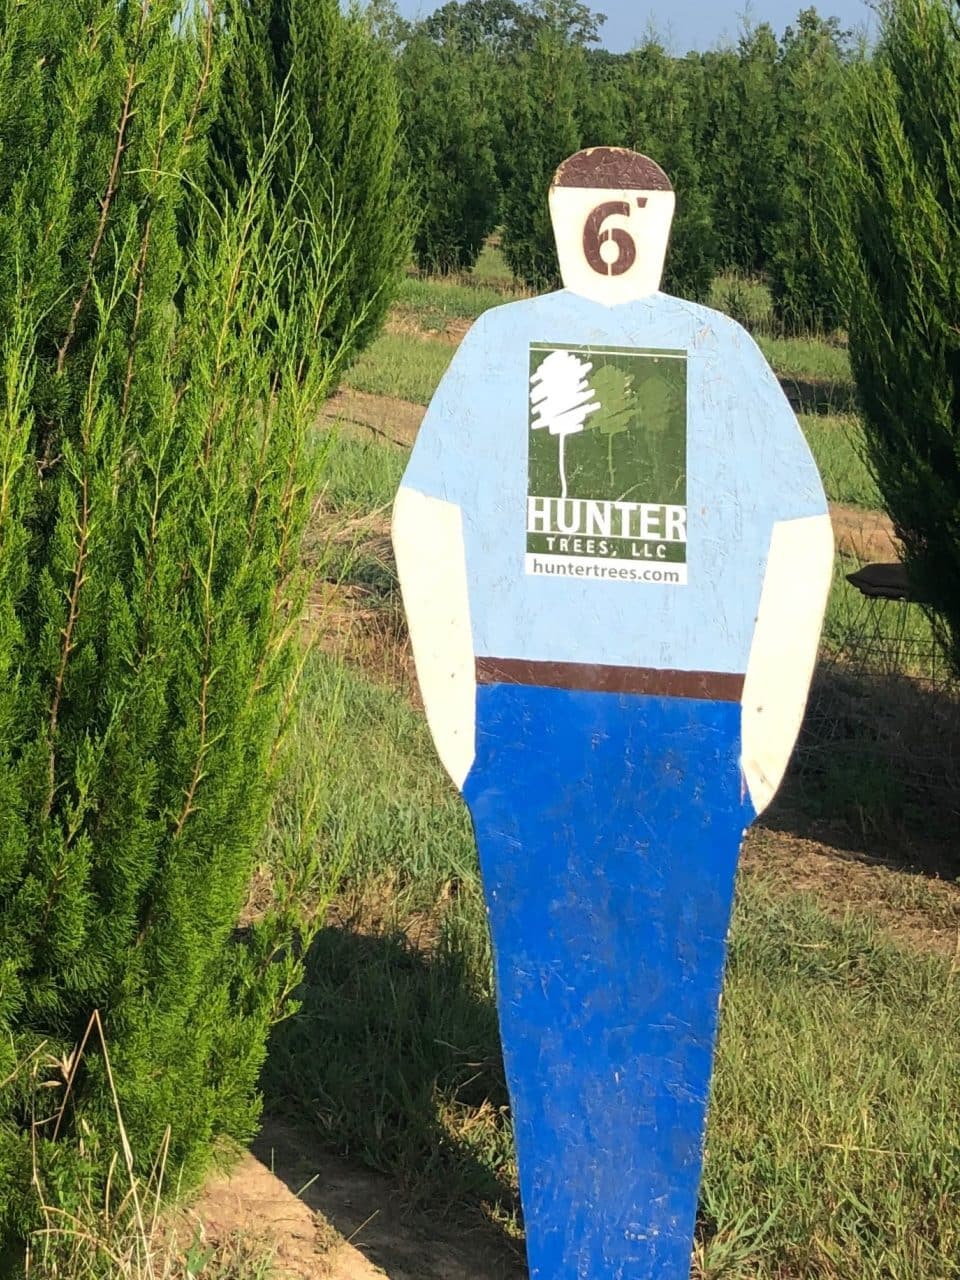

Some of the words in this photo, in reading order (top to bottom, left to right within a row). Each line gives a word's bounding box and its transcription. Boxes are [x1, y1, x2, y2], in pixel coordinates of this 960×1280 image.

[583, 197, 648, 276] 6'
[527, 497, 688, 541] HUNTER
[632, 543, 667, 558] LLC
[533, 559, 679, 582] huntertrees.com
